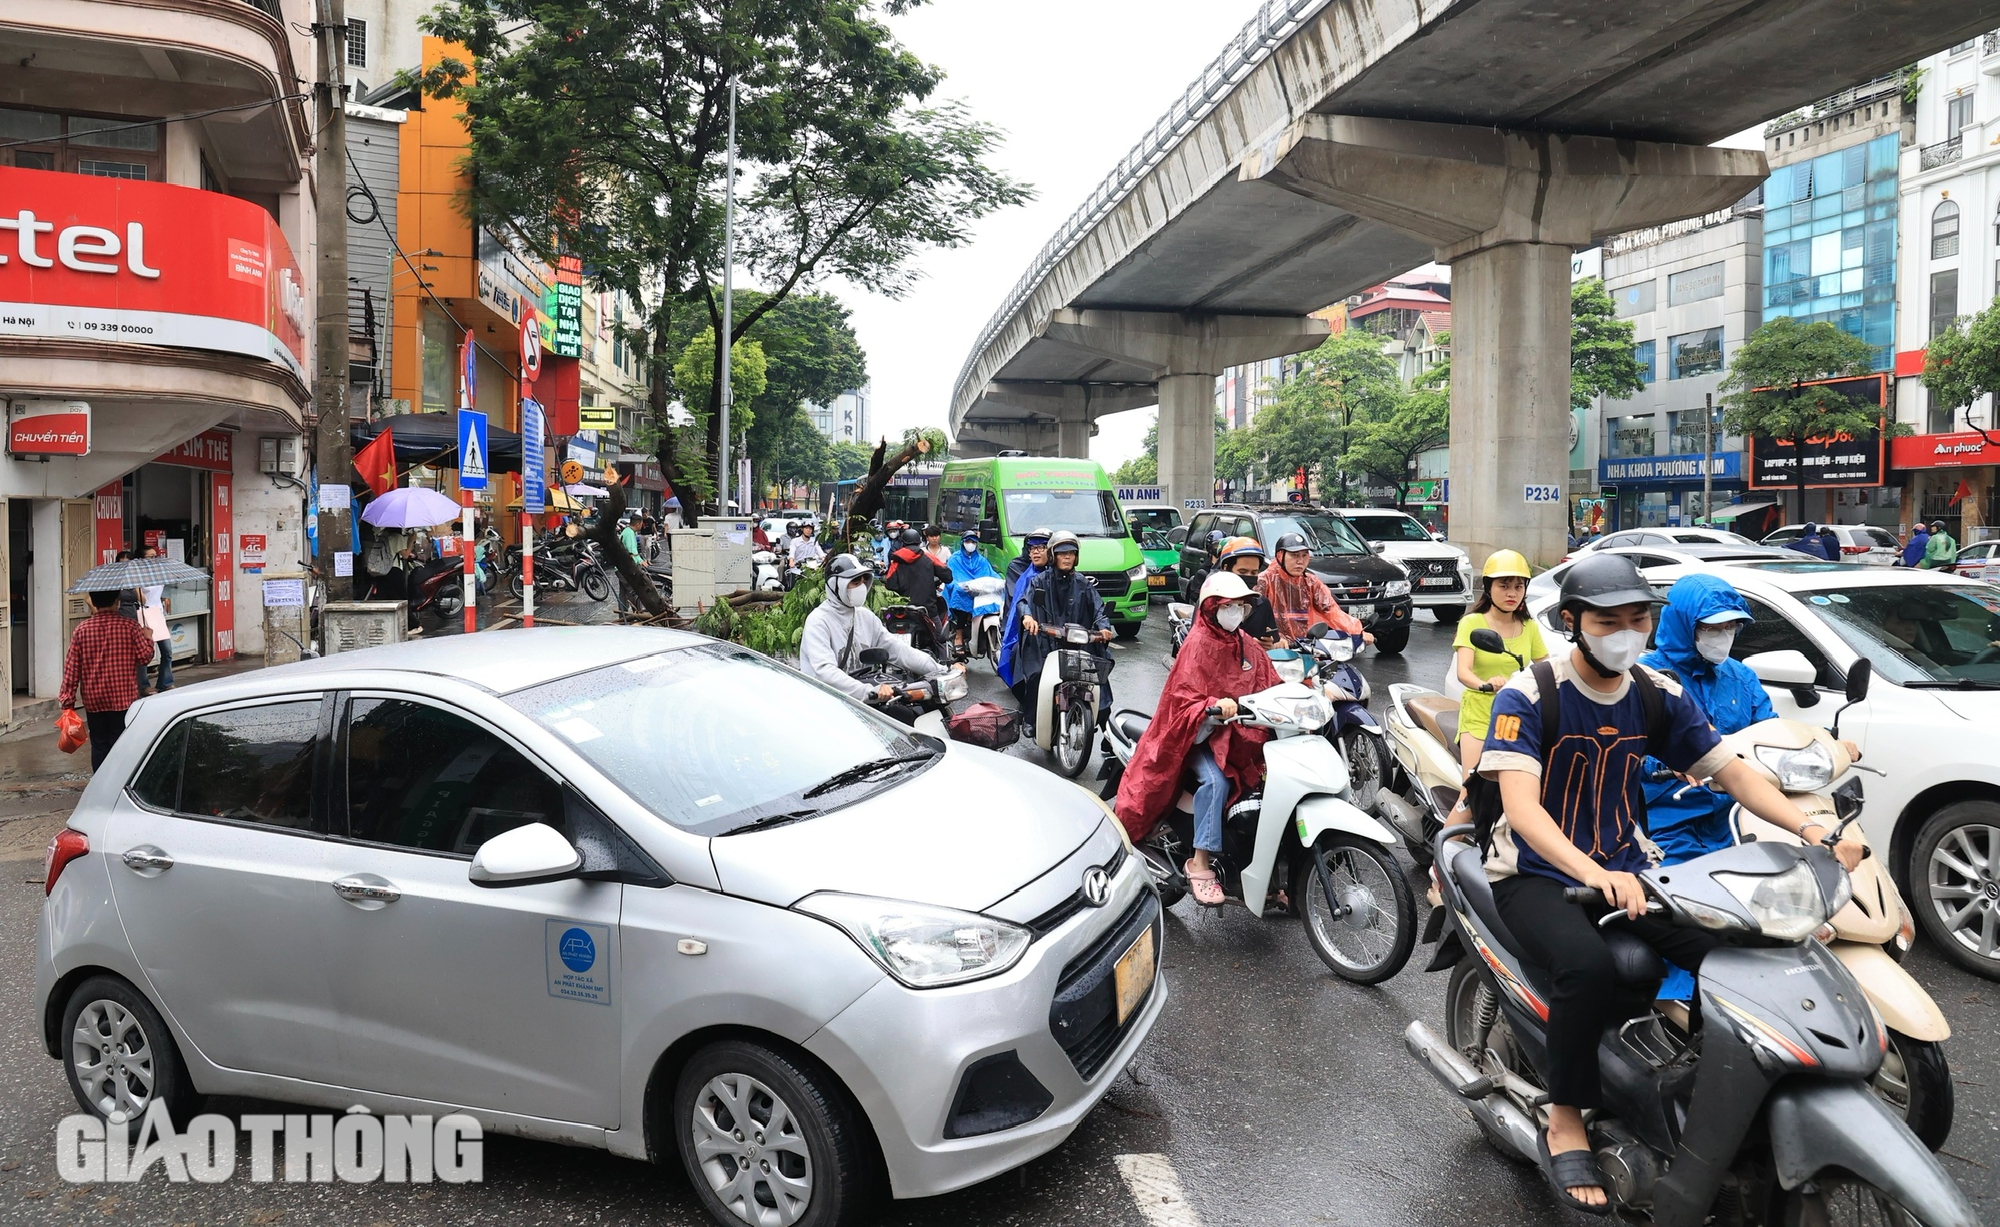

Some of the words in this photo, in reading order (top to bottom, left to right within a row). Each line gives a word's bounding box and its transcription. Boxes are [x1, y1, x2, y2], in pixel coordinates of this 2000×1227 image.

[0, 210, 160, 278] tel
[1613, 237, 1632, 253] NHA
[1634, 228, 1659, 247] KHOA
[558, 284, 580, 295] GIAO
[558, 293, 580, 306] DỊCH
[561, 306, 576, 318] TẠI
[3, 316, 16, 325] Hà
[19, 317, 35, 327] Nội
[559, 319, 580, 331] NHÀ
[84, 322, 98, 330] 09
[100, 323, 118, 332] 339
[121, 325, 153, 334] 00000
[557, 331, 580, 344] MIỄN
[561, 344, 577, 355] PHÍ
[1607, 464, 1626, 478] NHA
[1628, 463, 1653, 477] KHOA
[1655, 460, 1696, 476] PHƯƠNG
[1118, 489, 1134, 500] AN
[1136, 489, 1160, 500] ANH
[1525, 487, 1559, 501] P234
[1185, 500, 1205, 509] P233
[245, 544, 260, 552] 4G
[1785, 964, 1823, 976] HONDA
